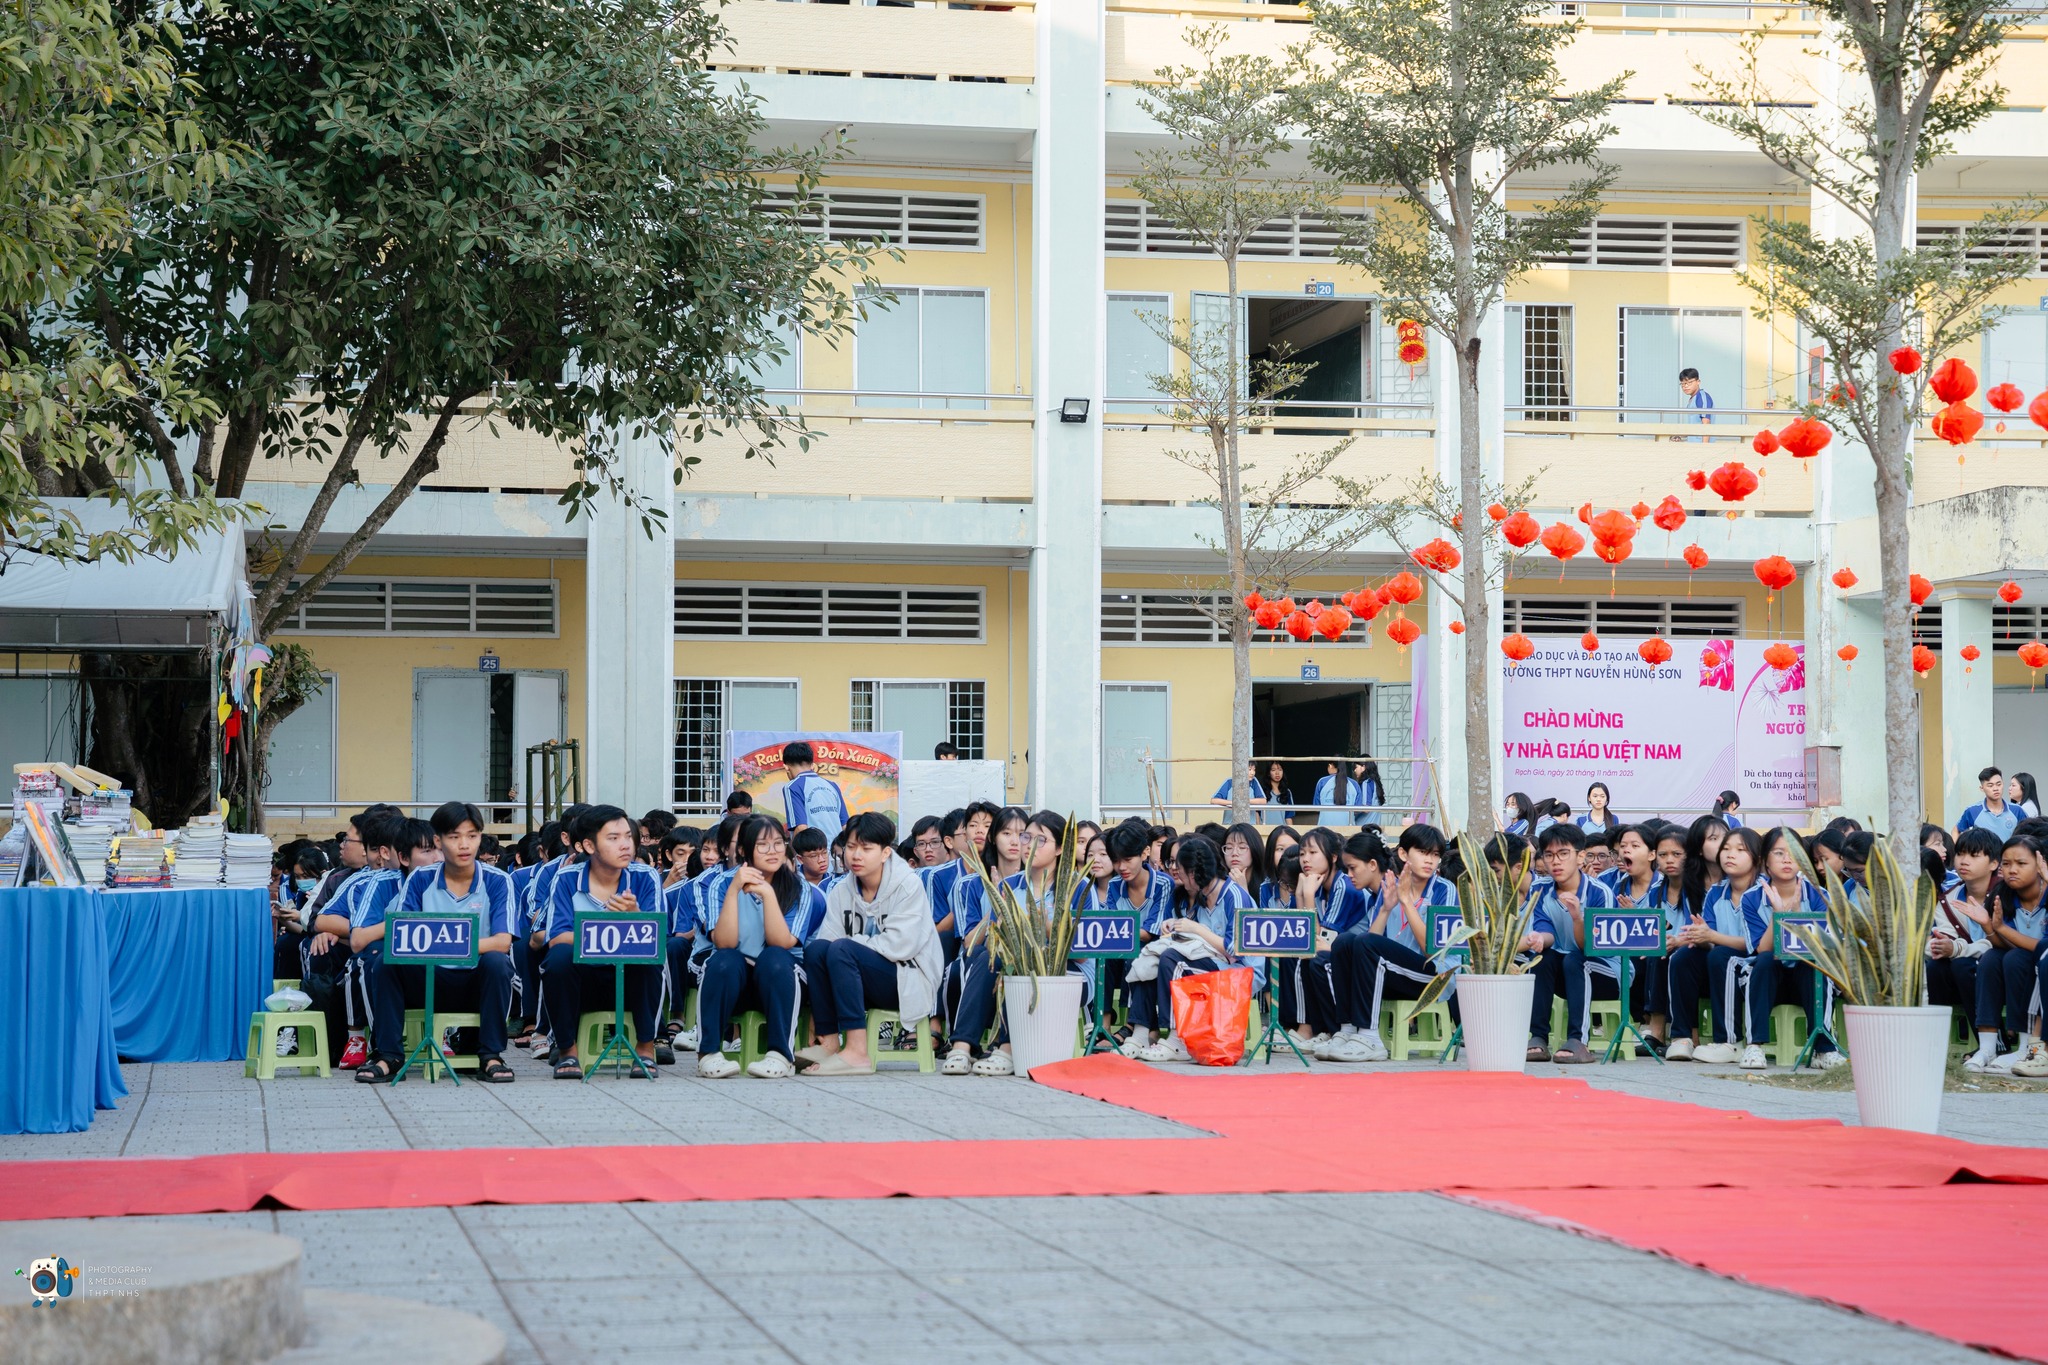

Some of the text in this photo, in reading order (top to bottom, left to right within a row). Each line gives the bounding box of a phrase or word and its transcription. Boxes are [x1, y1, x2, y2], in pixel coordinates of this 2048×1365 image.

[1319, 285, 1332, 295] 20
[1545, 651, 1565, 663] DỤC
[1567, 649, 1579, 660] VÀ
[1604, 652, 1622, 663] TẠO
[1625, 652, 1638, 661] AN
[483, 659, 497, 669] 25
[1503, 663, 1681, 679] RƯỜNG THPT NGUYỄN HÙNG SƠN
[1304, 668, 1317, 678] 26
[1524, 708, 1624, 729] CHÀO MỪNG
[1765, 719, 1805, 735] NGƯỜ
[817, 745, 844, 760] Đón
[846, 748, 880, 767] Xuân
[1518, 739, 1553, 759] NHÀ
[1557, 739, 1599, 759] GIÁO
[1603, 740, 1641, 763] VIỆT
[1644, 744, 1682, 760] NAM
[1547, 769, 1565, 778] ngày
[1575, 769, 1595, 778] tháng
[1619, 769, 1634, 777] 2025
[1744, 769, 1755, 778] Dù
[1757, 769, 1772, 778] cho
[1774, 770, 1793, 780] tung
